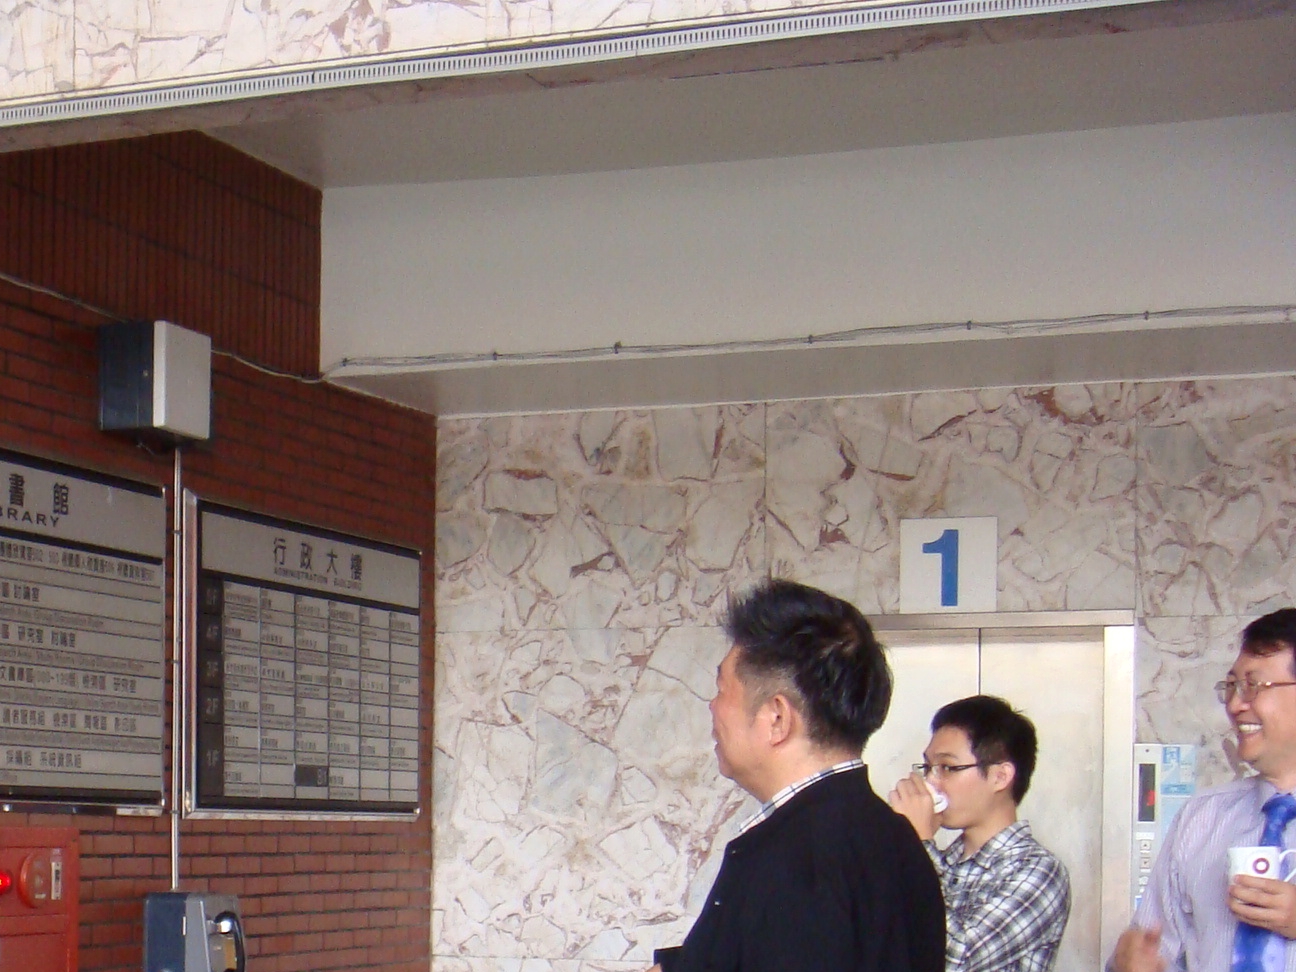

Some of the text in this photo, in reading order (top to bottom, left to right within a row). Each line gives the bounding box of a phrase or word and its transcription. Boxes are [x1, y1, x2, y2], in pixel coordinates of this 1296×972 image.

[273, 537, 363, 581] 行政大樓
[922, 528, 959, 607] 1
